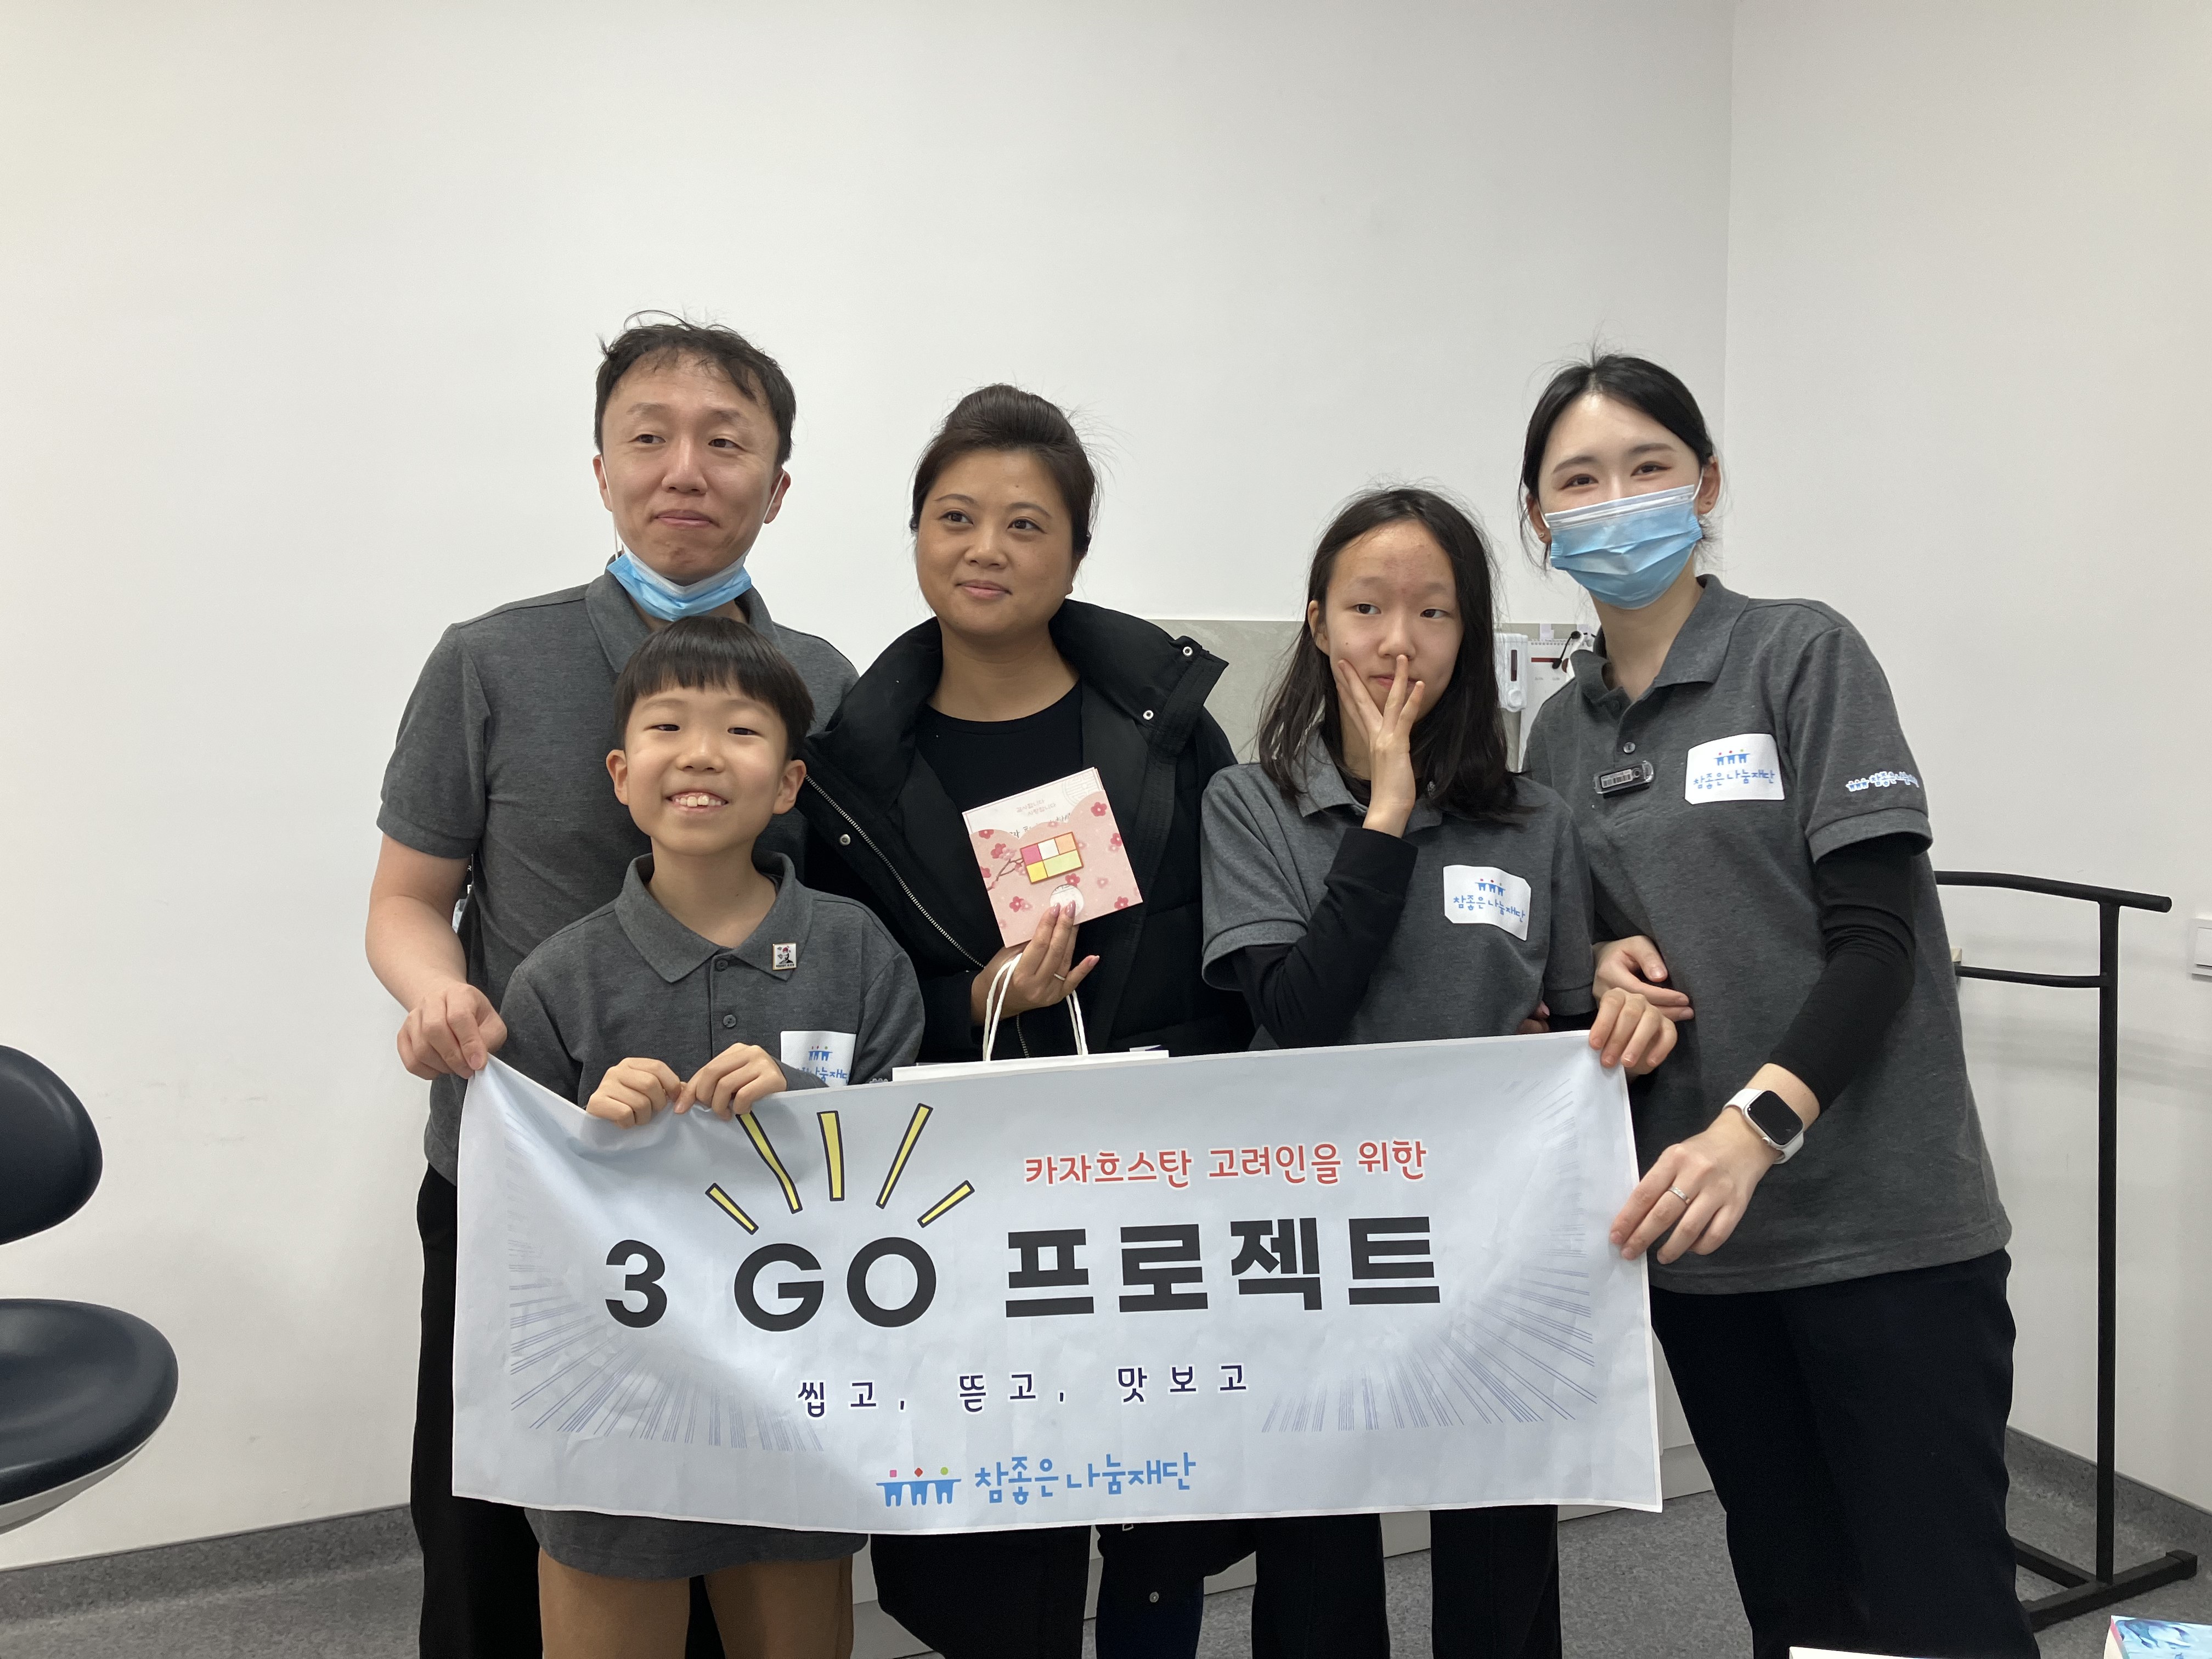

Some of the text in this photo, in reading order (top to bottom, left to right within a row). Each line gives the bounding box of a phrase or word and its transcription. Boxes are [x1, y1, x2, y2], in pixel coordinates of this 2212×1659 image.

[1025, 1139, 1427, 1188] 카자흐스탄 고려인을 위한
[605, 1216, 1441, 1332] 3 GO 프로젝트
[1117, 1364, 1248, 1403] 맛보고
